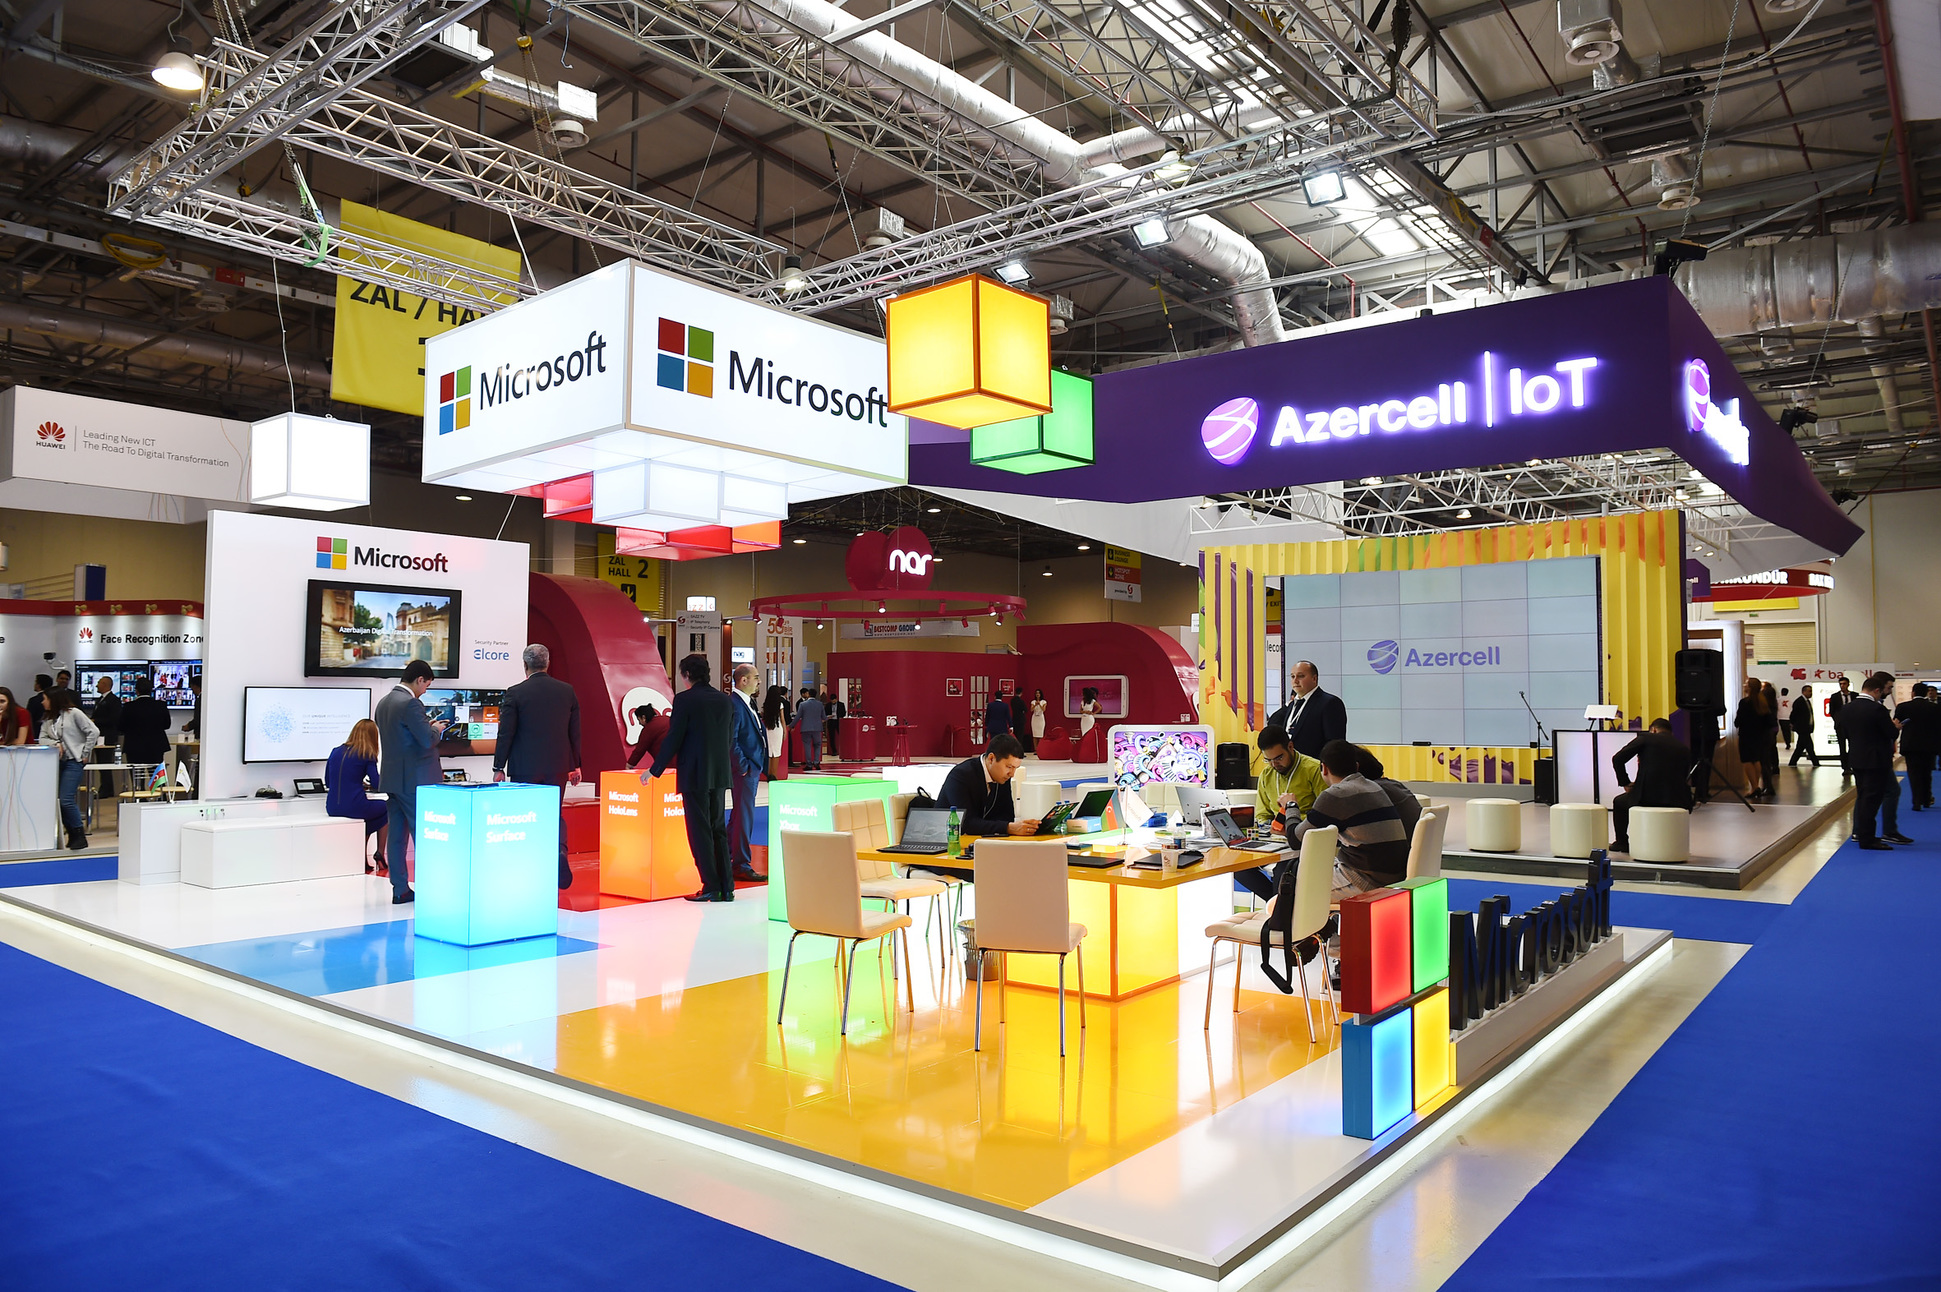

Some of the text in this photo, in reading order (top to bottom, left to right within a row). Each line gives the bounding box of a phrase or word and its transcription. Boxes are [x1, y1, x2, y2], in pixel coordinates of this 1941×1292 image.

[350, 278, 407, 313] ZAL
[480, 330, 606, 410] Microsoft
[729, 349, 888, 427] Microsoft
[1270, 357, 1598, 447] Azercell IoT
[36, 441, 66, 450] HUAWEI
[83, 430, 156, 447] Leading New ICT
[83, 441, 229, 468] The Road To Digital Transformation
[354, 546, 448, 573] Microsoft
[609, 556, 626, 566] ZAL
[889, 549, 933, 576] nar
[609, 567, 631, 577] HALL
[638, 559, 649, 579] 2
[339, 626, 371, 635] Azerbaijan
[100, 634, 122, 644] Face
[125, 634, 181, 645] Recognition
[1405, 646, 1500, 667] Azercell
[609, 791, 639, 803] Microsoft
[486, 811, 537, 826] Microsoft
[608, 805, 638, 817] HoloLens
[780, 804, 818, 817] Microsoft
[780, 820, 800, 831] Xbox
[486, 830, 526, 843] Surface
[1450, 848, 1613, 1031] Microsoft
